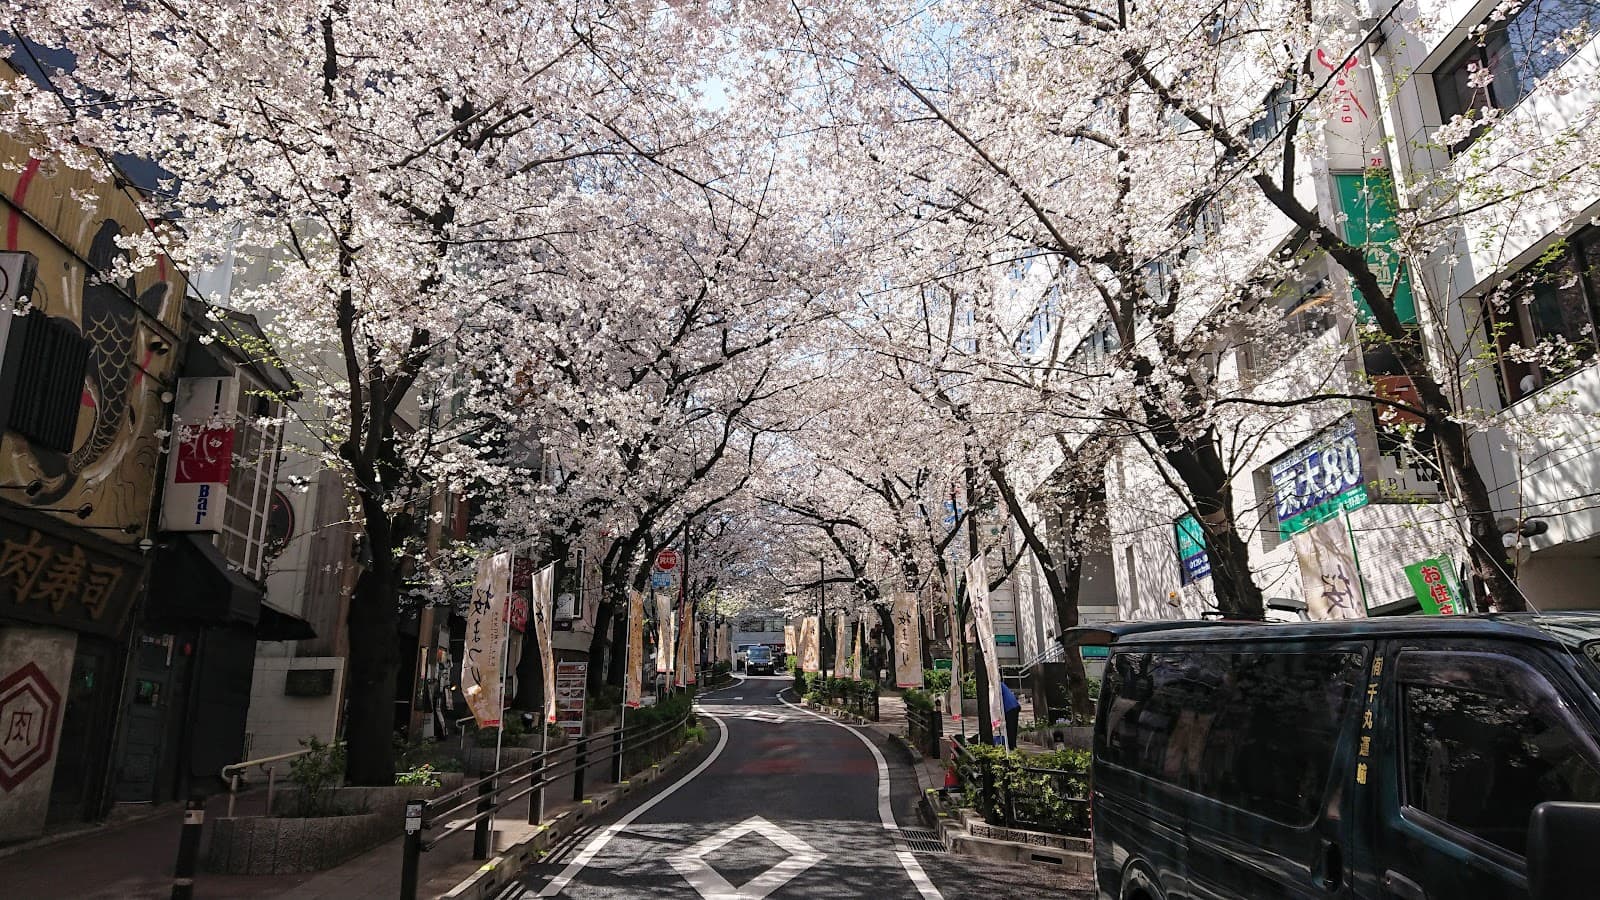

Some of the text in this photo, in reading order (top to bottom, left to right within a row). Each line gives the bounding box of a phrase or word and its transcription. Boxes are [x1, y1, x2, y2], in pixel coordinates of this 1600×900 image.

[1370, 158, 1383, 167] 2F
[195, 484, 210, 525] Bar
[1273, 436, 1361, 517] 東大80
[0, 528, 123, 619] 肉寿司
